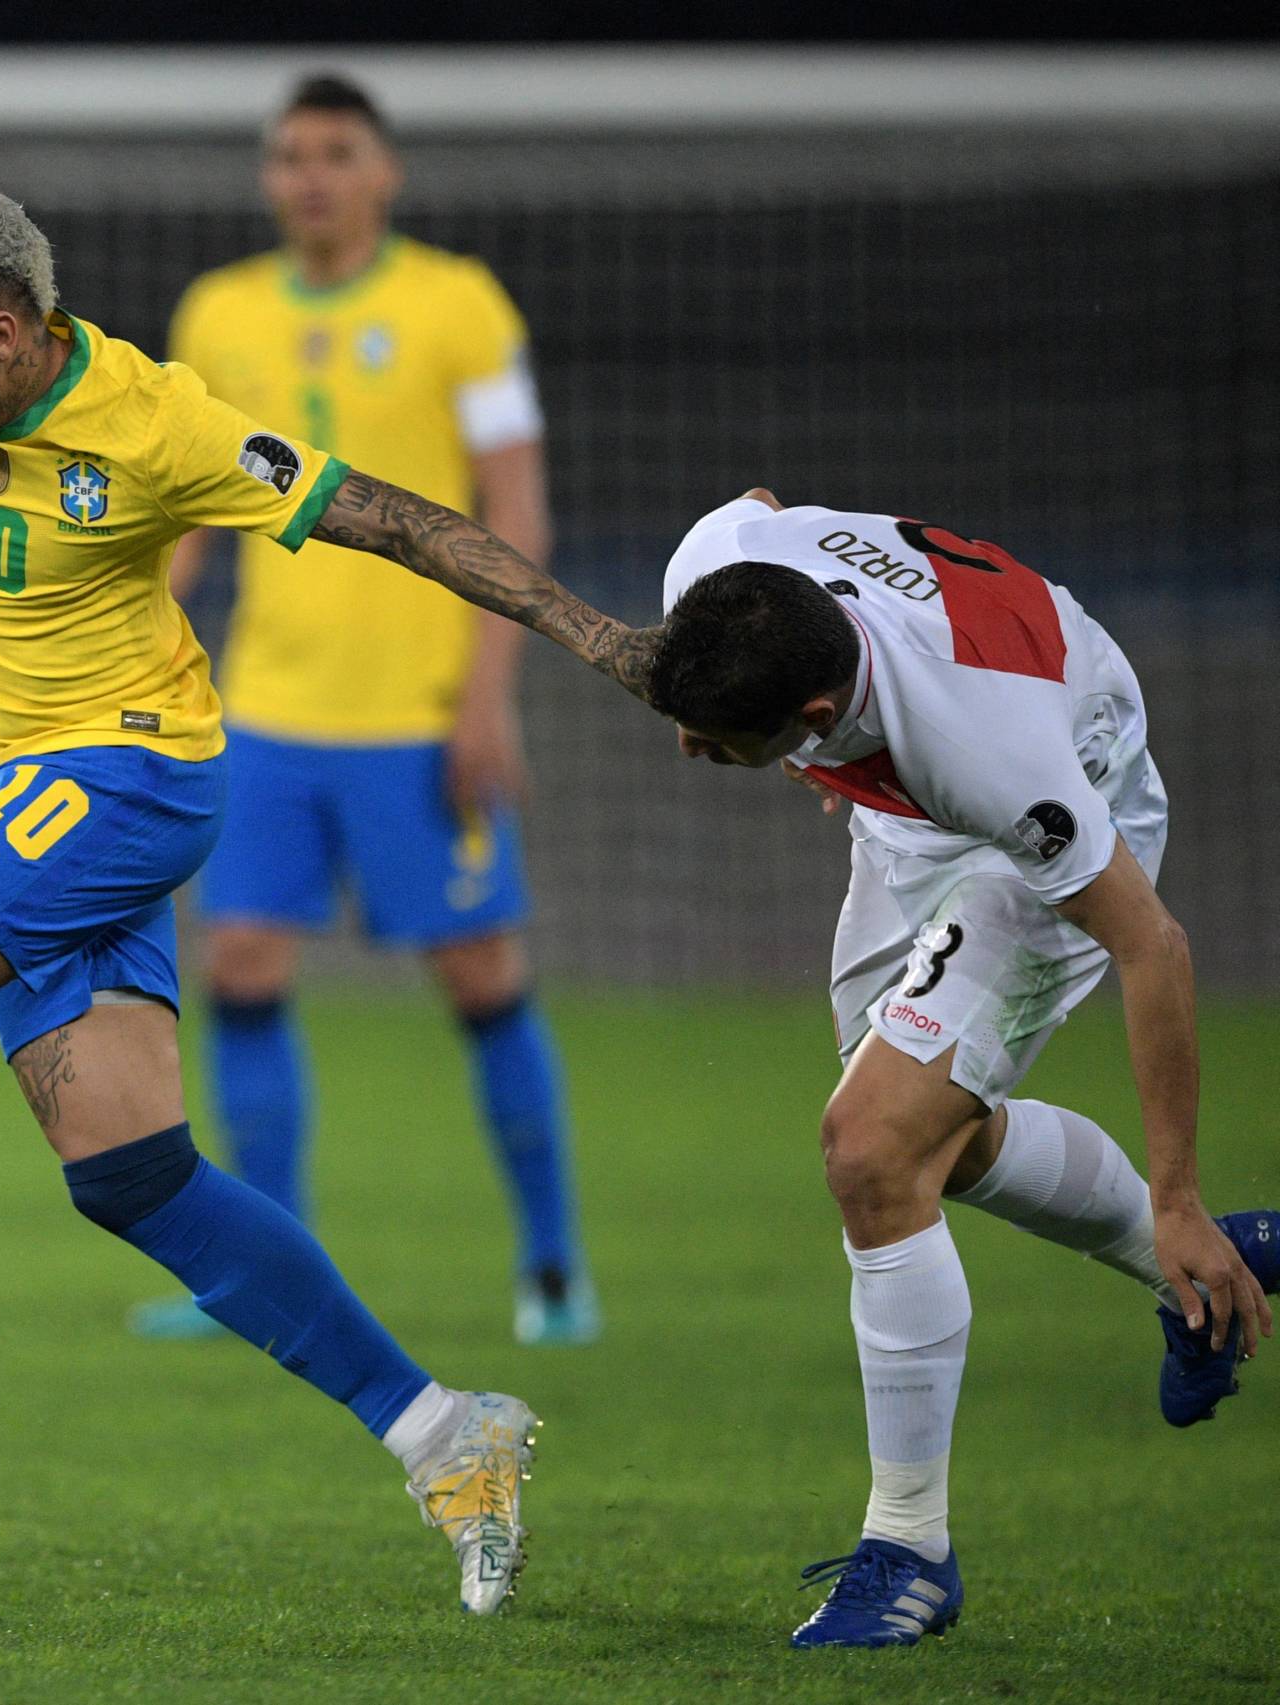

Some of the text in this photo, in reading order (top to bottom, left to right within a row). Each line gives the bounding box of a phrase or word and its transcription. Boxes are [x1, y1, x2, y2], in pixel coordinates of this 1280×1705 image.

[74, 486, 94, 496] CBF
[57, 519, 115, 536] BRASIL
[818, 531, 943, 600] CORZO
